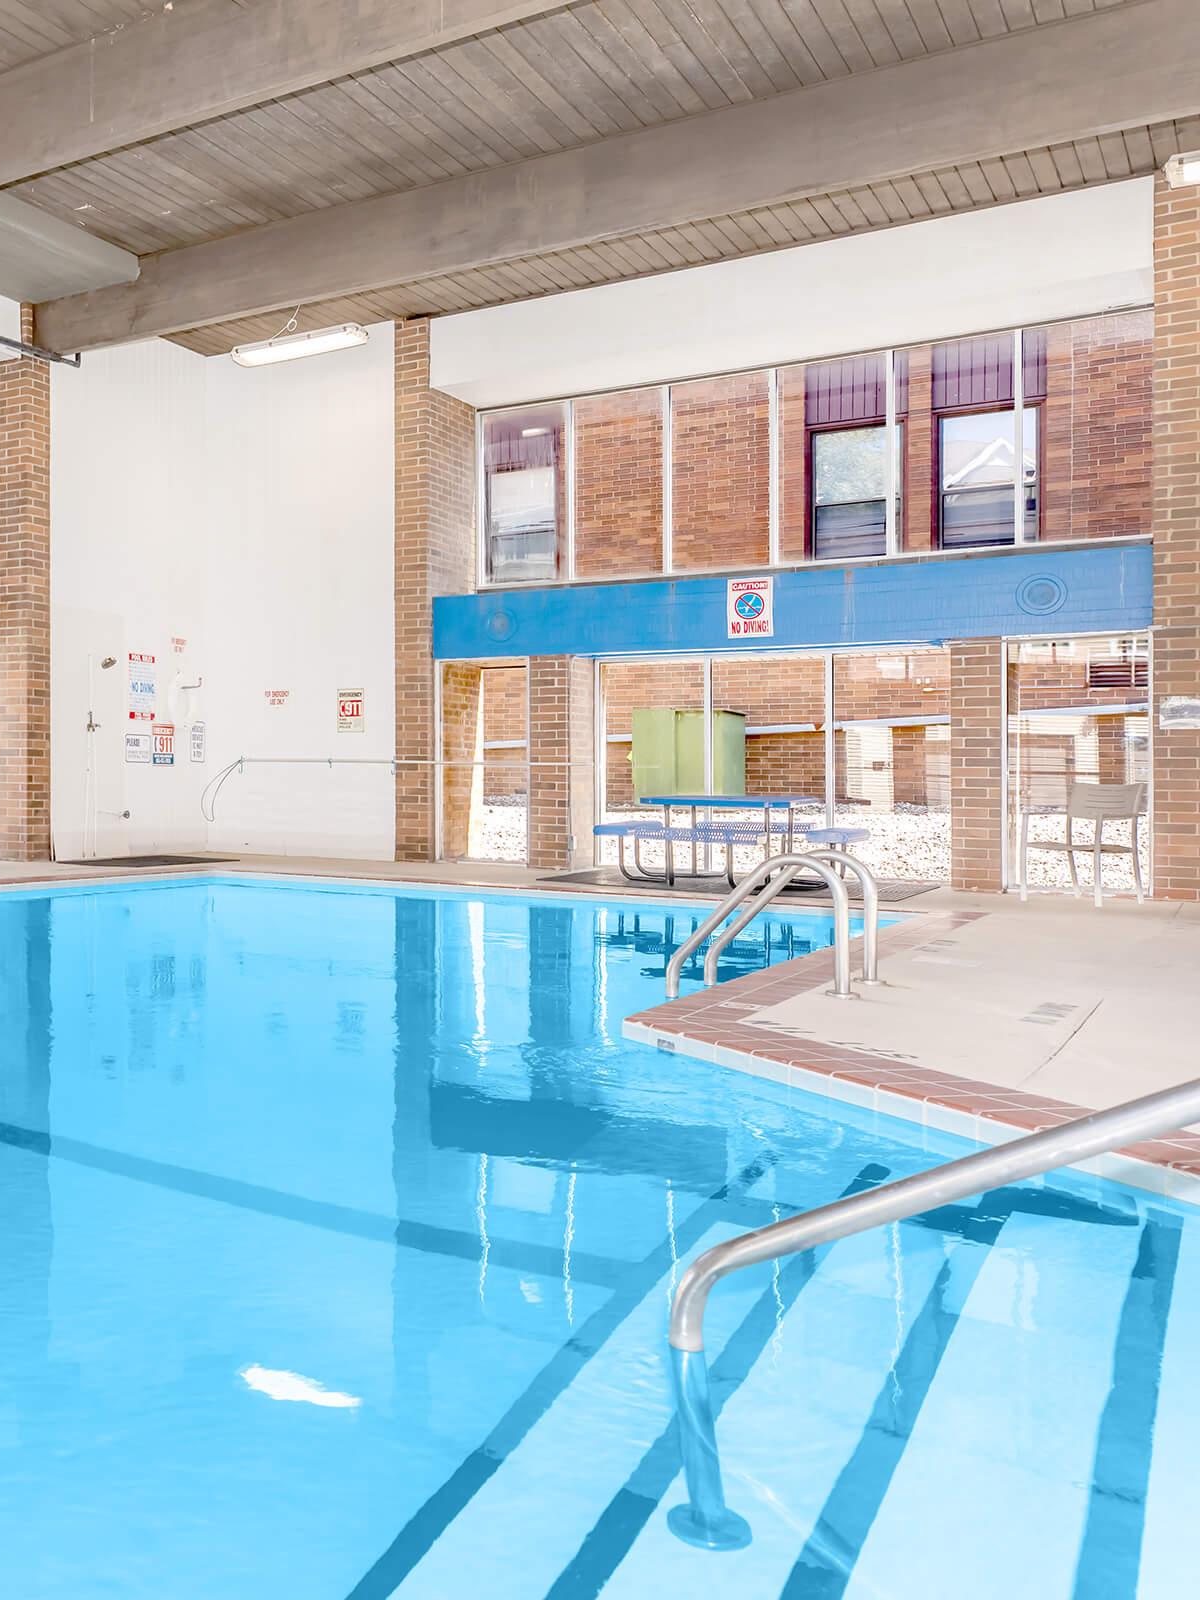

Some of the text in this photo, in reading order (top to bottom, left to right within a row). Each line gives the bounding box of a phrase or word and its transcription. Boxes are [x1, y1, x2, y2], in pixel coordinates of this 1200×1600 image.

[732, 582, 768, 591] CAUTION!
[731, 620, 769, 634] NO DIVING!
[131, 681, 139, 693] NO
[345, 702, 361, 715] 911
[159, 736, 173, 753] 911
